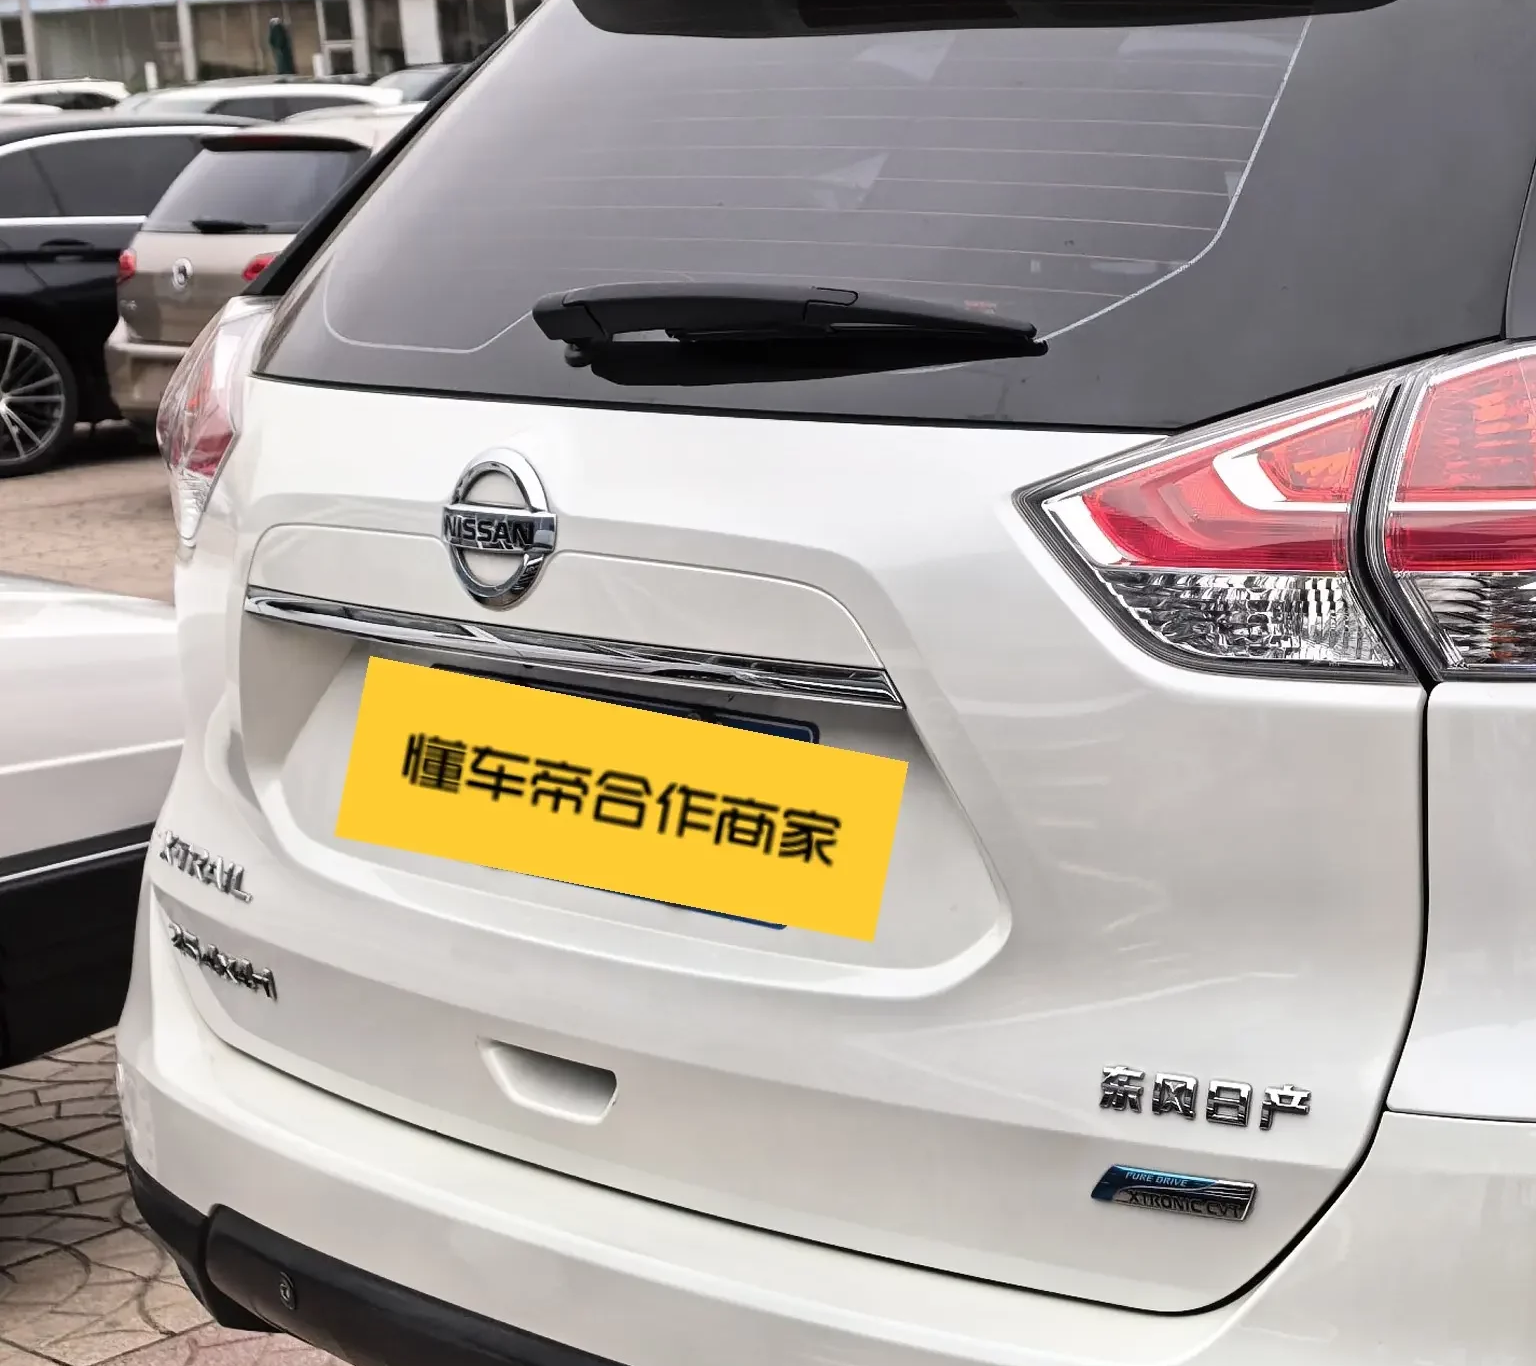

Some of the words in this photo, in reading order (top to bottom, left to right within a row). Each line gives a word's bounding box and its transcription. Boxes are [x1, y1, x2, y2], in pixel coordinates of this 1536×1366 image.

[444, 512, 535, 547] NISSAN
[1099, 1065, 1312, 1131] 东风日产
[1125, 1171, 1153, 1183] PURE
[1155, 1175, 1188, 1187] DRIVE
[1128, 1191, 1202, 1214] XTRONIC
[1206, 1200, 1242, 1220] CVT
